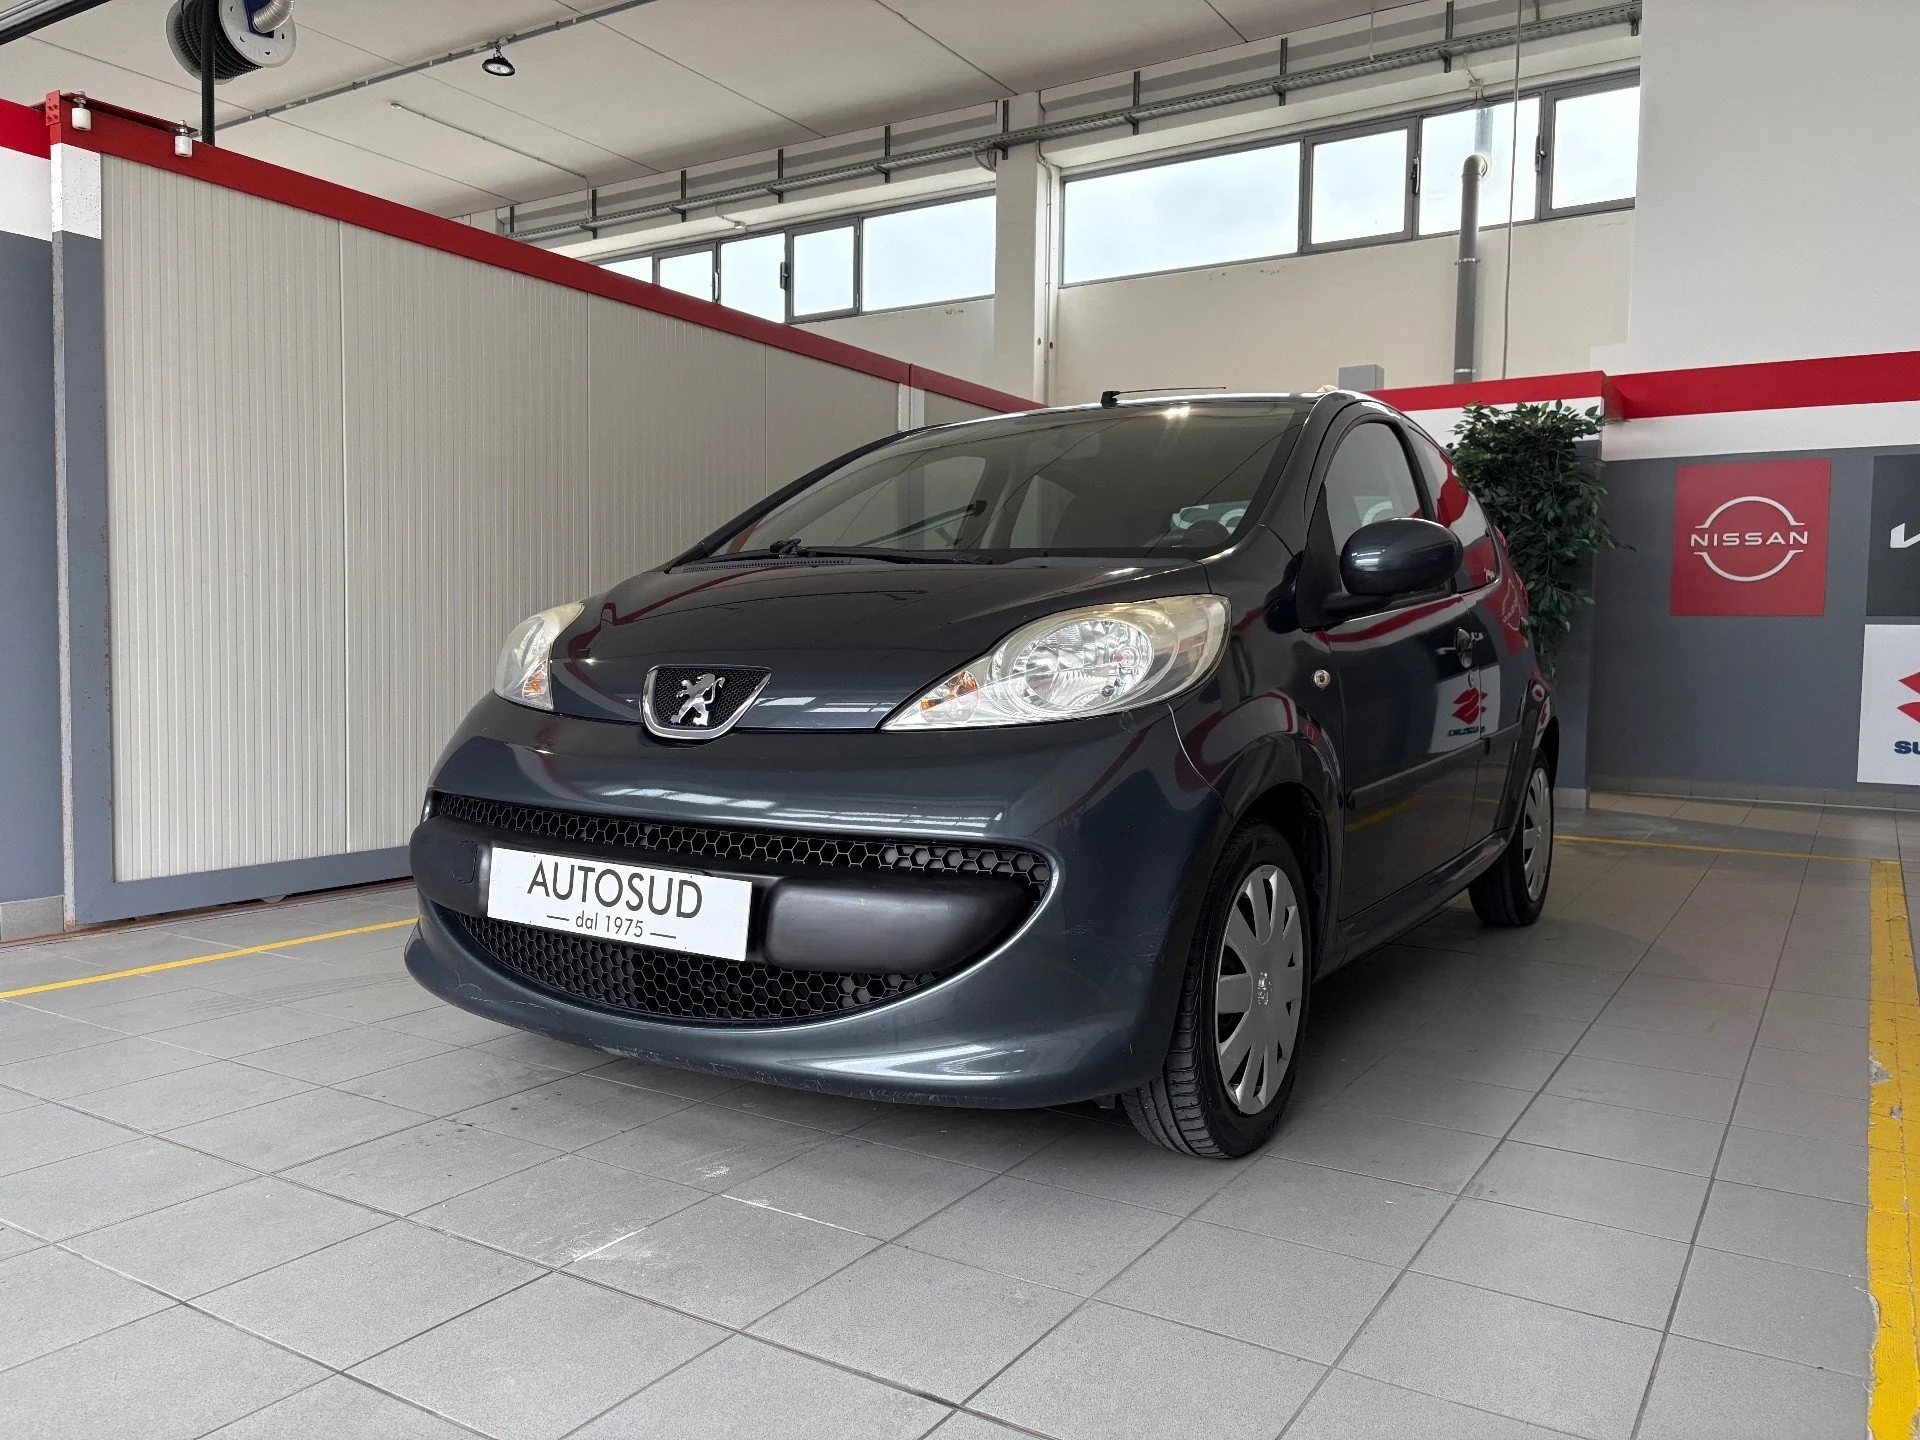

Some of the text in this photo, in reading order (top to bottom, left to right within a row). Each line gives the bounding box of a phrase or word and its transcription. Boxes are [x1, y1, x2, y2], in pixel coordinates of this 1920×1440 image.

[1690, 531, 1808, 547] NISSAN
[527, 859, 703, 918] AUTOSUD
[575, 910, 644, 938] dal 1975
